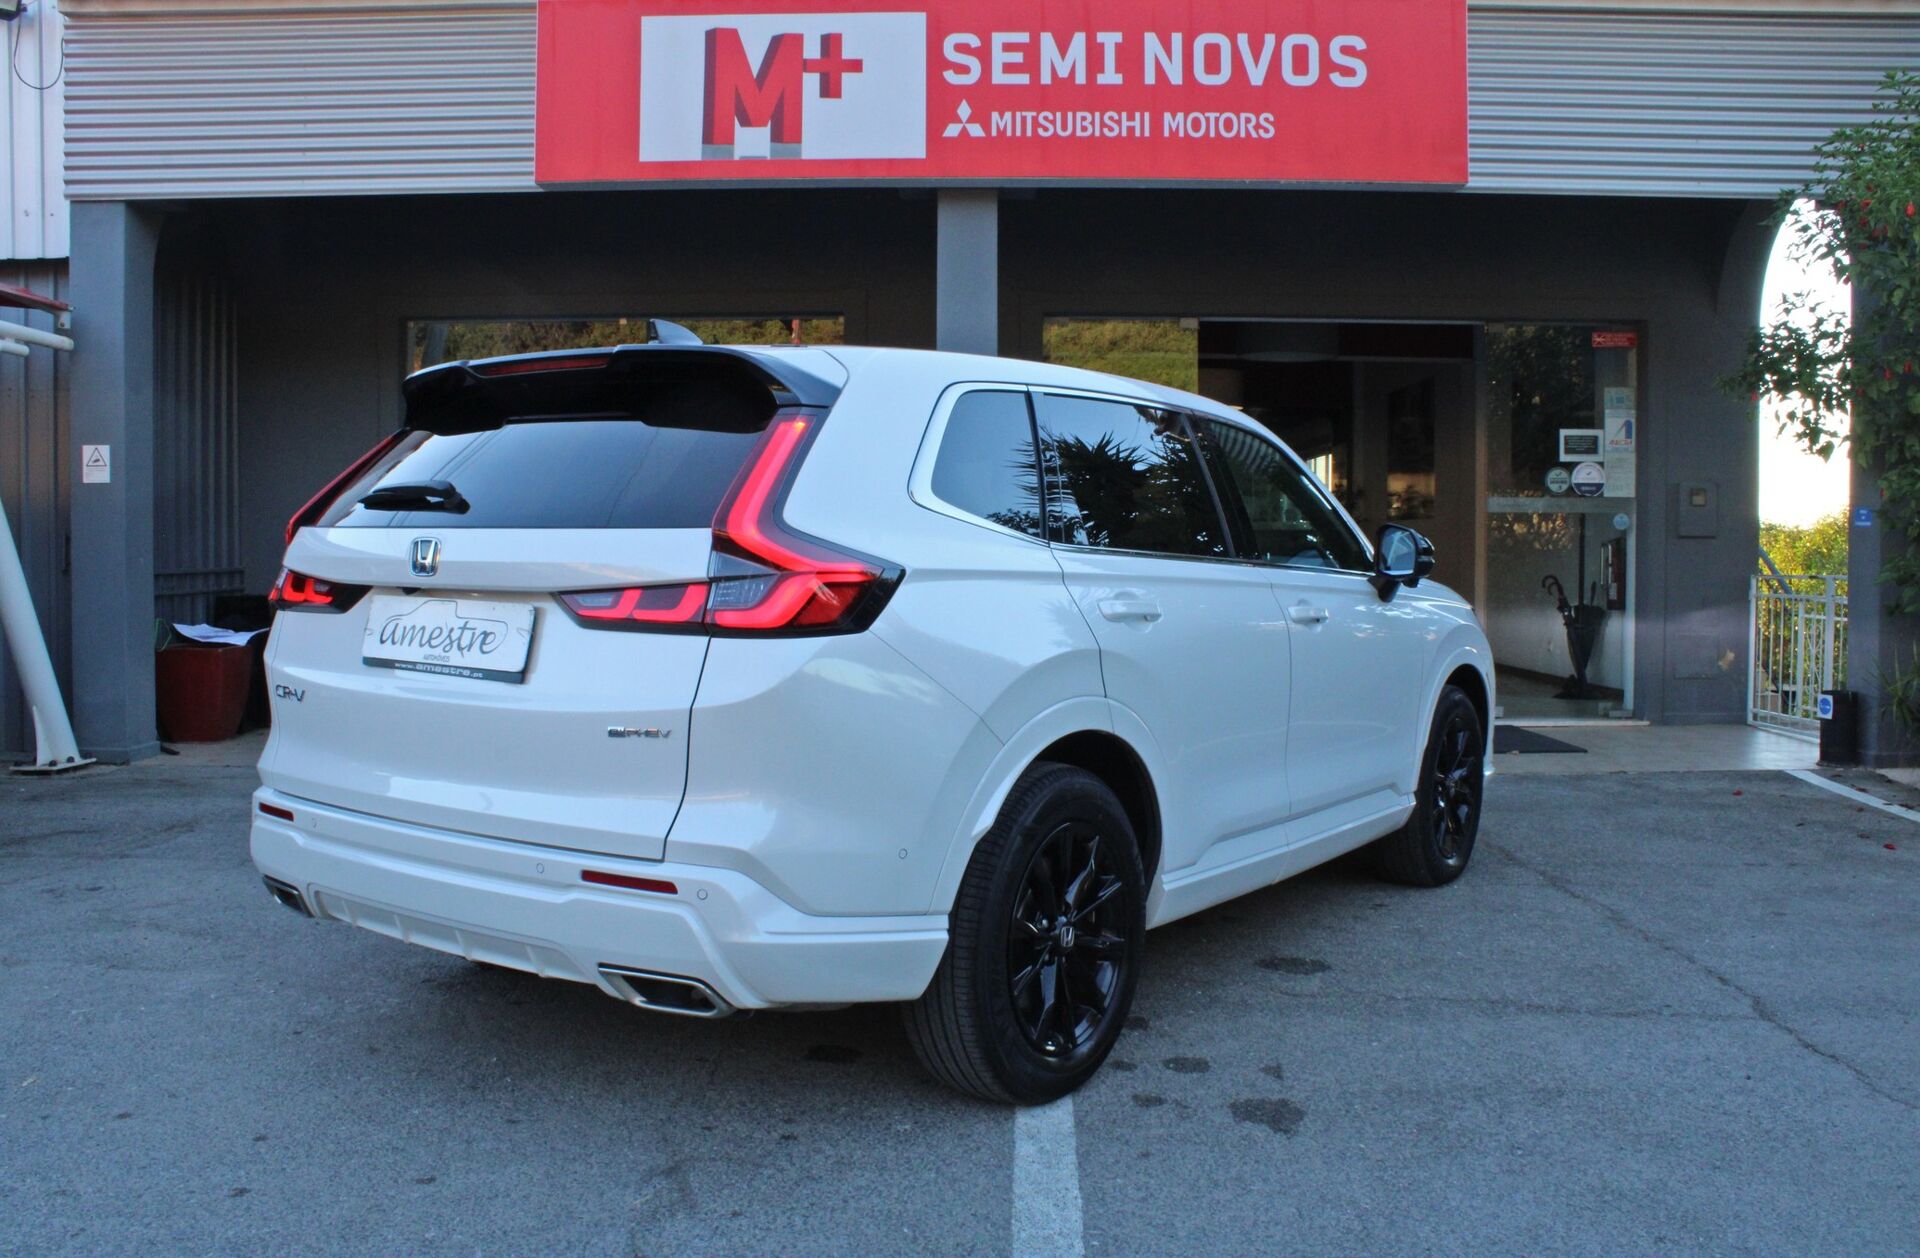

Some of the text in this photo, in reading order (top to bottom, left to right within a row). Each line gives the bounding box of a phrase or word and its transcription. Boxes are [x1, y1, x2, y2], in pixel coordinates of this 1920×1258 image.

[942, 31, 1368, 88] SEMI NOVOS
[990, 110, 1276, 139] MITSUBISHI MOTORS
[379, 618, 498, 656] amestre
[394, 662, 484, 679] www.amestre.pt
[275, 684, 306, 702] CR-V
